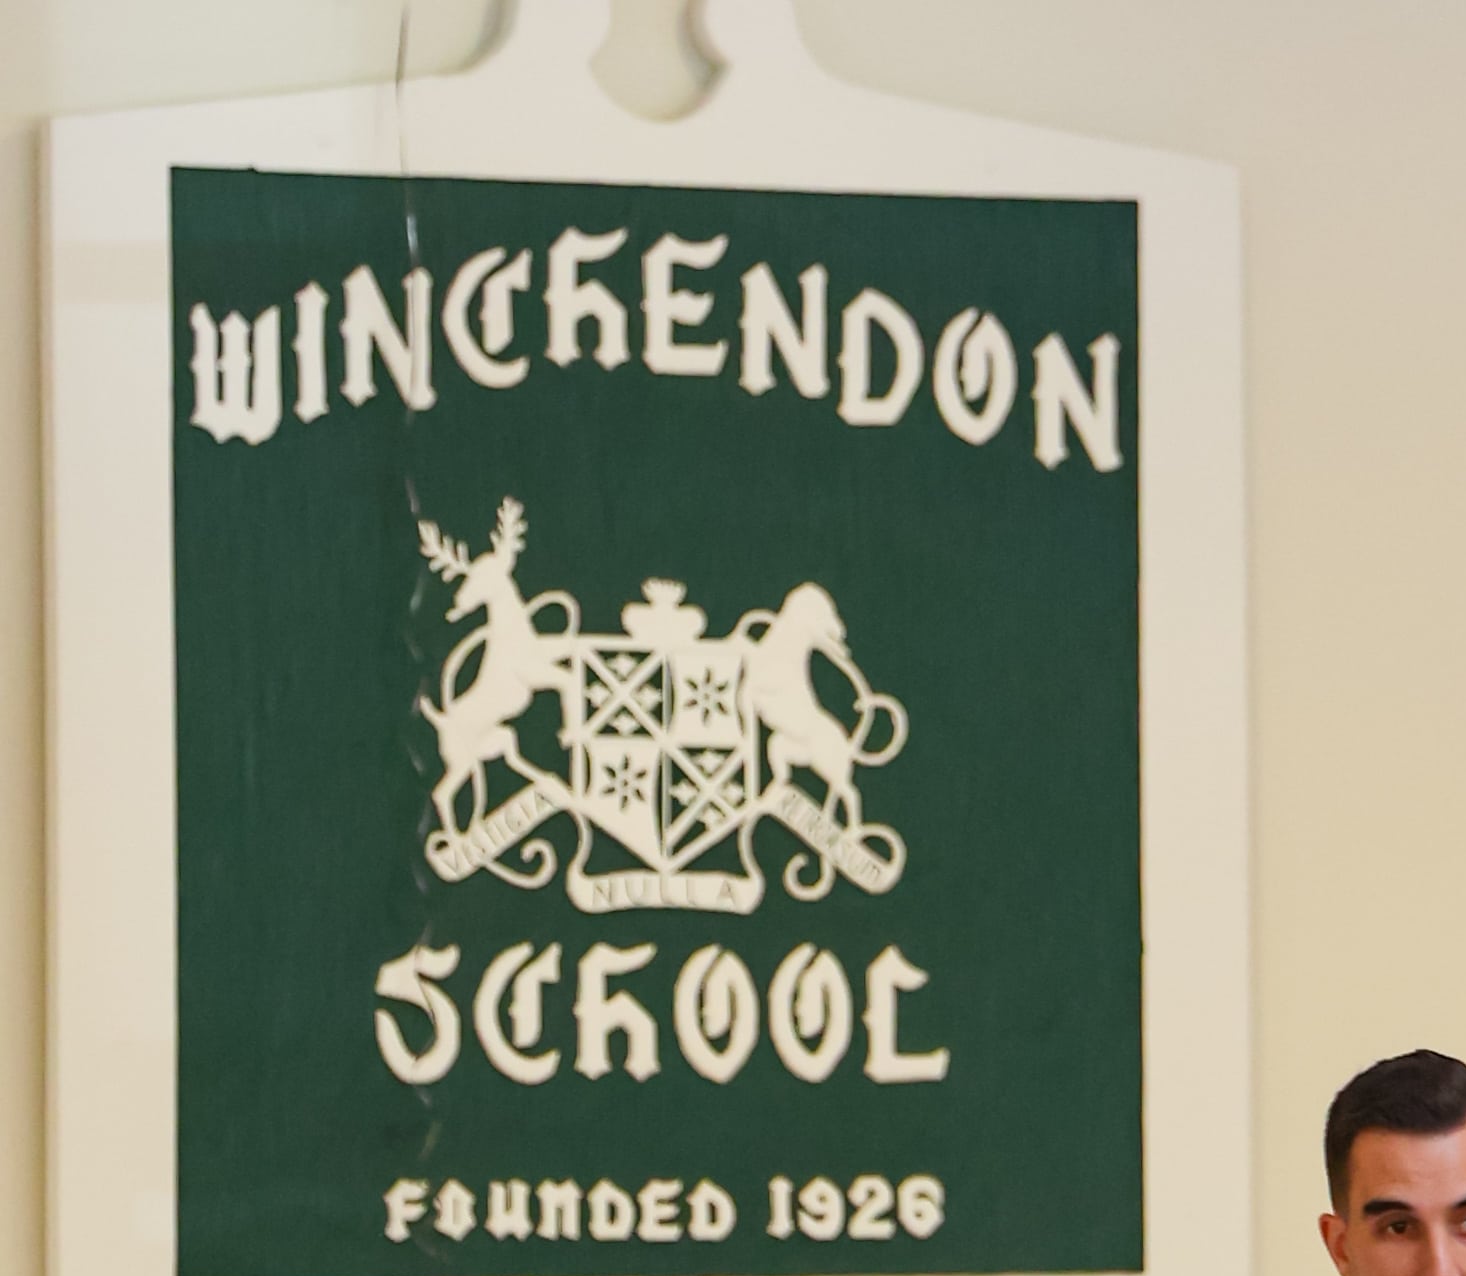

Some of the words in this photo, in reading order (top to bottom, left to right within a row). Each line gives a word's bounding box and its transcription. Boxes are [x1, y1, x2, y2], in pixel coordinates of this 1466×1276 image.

[190, 227, 1121, 473] WINCHENDON
[592, 871, 738, 909] NULLA
[375, 942, 950, 1085] SCHOOL
[384, 1179, 737, 1242] FOUNDED
[766, 1174, 944, 1241] 1926
